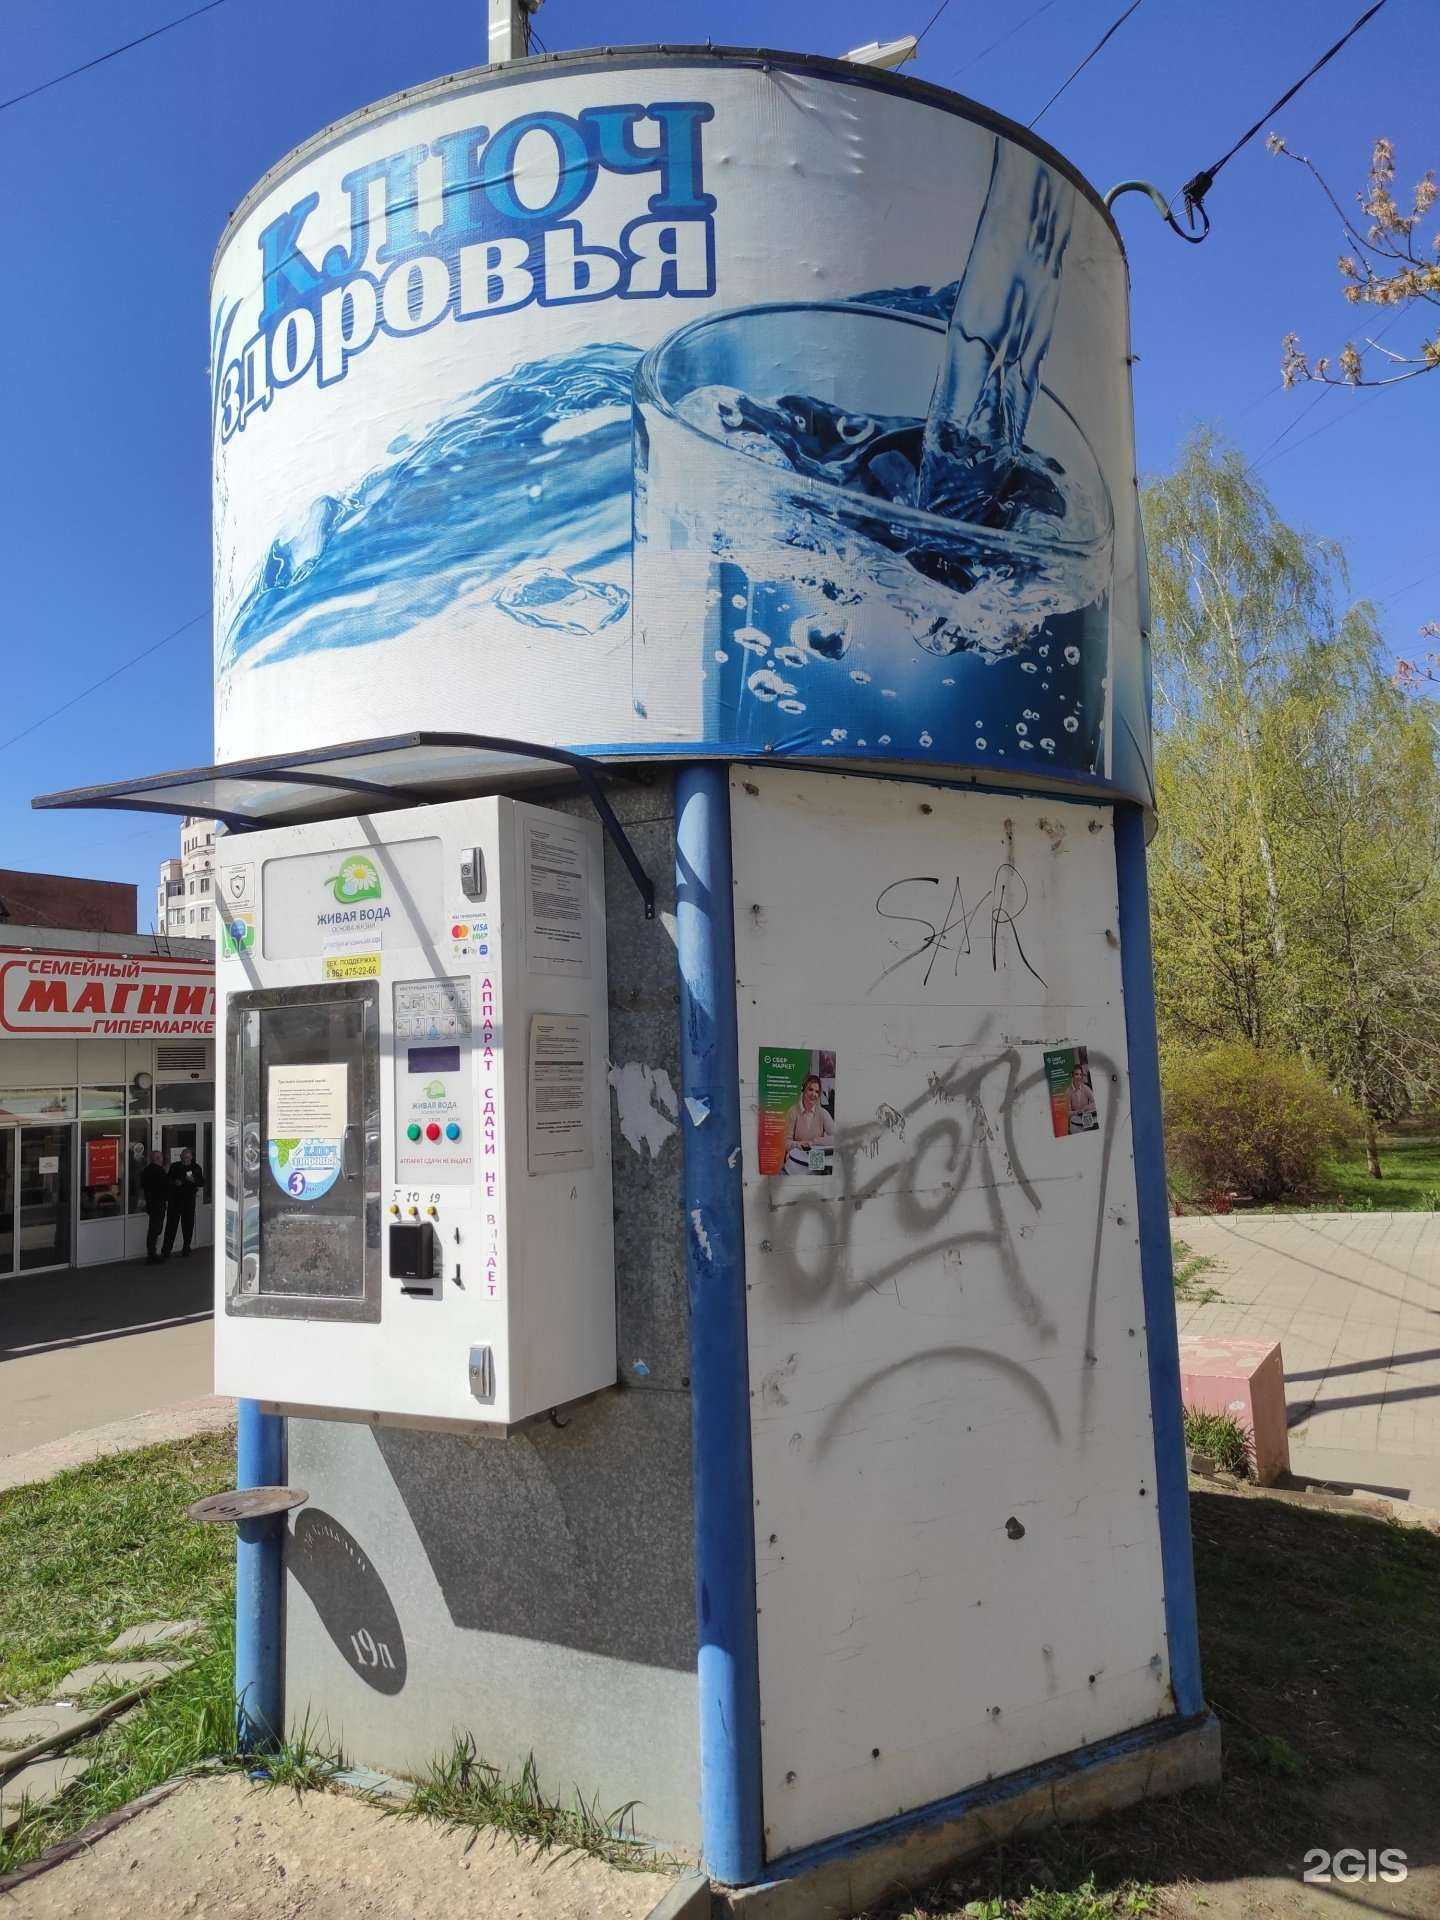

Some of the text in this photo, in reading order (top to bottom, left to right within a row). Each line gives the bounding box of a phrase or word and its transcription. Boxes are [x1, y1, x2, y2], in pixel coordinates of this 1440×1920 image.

[258, 101, 717, 330] КЛЮЧ
[317, 906, 391, 926] ЖИВАЯ ВОДА
[472, 924, 488, 932] VISA
[28, 959, 141, 978] СЕМЕЙНЫЙ
[331, 968, 343, 977] 962
[481, 978, 495, 1072] АППАРАТ
[486, 1214, 498, 1296] ВАЕТ
